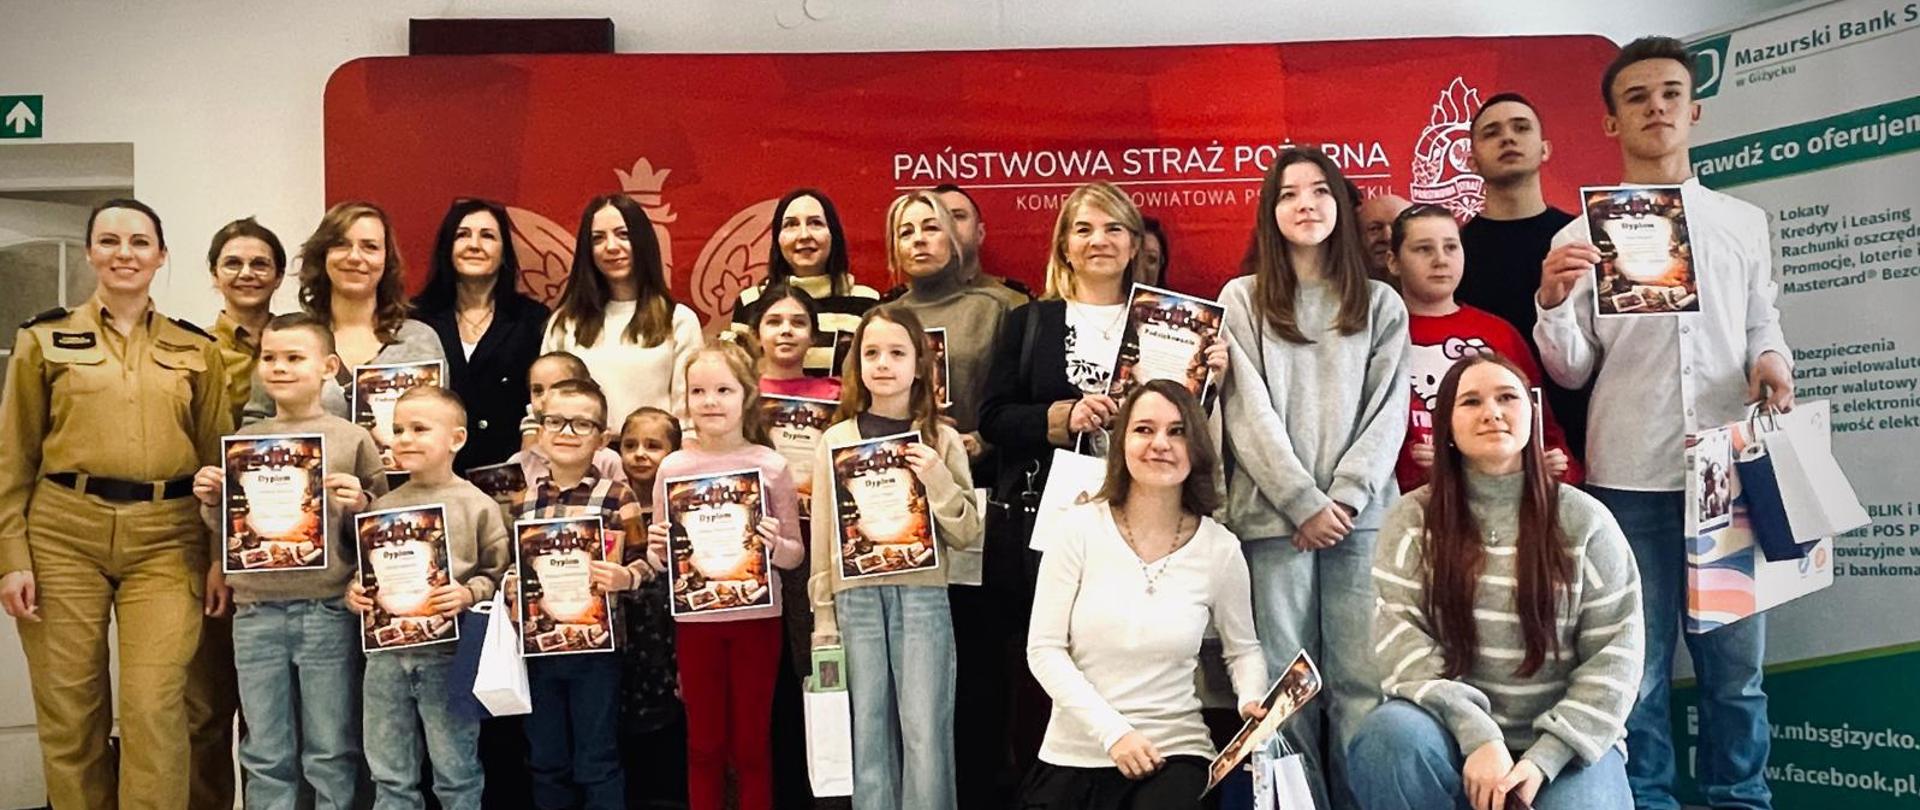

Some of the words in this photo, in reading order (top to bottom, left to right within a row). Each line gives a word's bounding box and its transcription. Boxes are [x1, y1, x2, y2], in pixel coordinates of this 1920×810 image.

[1735, 25, 1831, 67] Mazurski
[1839, 10, 1896, 40] Bank
[894, 146, 1114, 181] PAŃSTWOWA
[1123, 139, 1225, 175] STRAŻ
[1235, 138, 1390, 173] PORNA
[1692, 143, 1763, 176] rawdź
[1770, 141, 1800, 161] co
[1132, 190, 1237, 208] OWIATOWA
[1780, 204, 1829, 221] Lokaty
[1781, 221, 1838, 240] Kredyty
[1842, 215, 1847, 229] i
[1851, 207, 1912, 228] Leasing
[1781, 234, 1849, 258] Rachunki
[1783, 255, 1856, 276] Promocje,
[1860, 245, 1912, 264] loterie
[1881, 265, 1920, 281] Bezc
[1842, 378, 1918, 394] walutowy
[1868, 504, 1903, 517] BLIK
[1873, 523, 1905, 537] POS
[1833, 542, 1905, 560] rowizyjne
